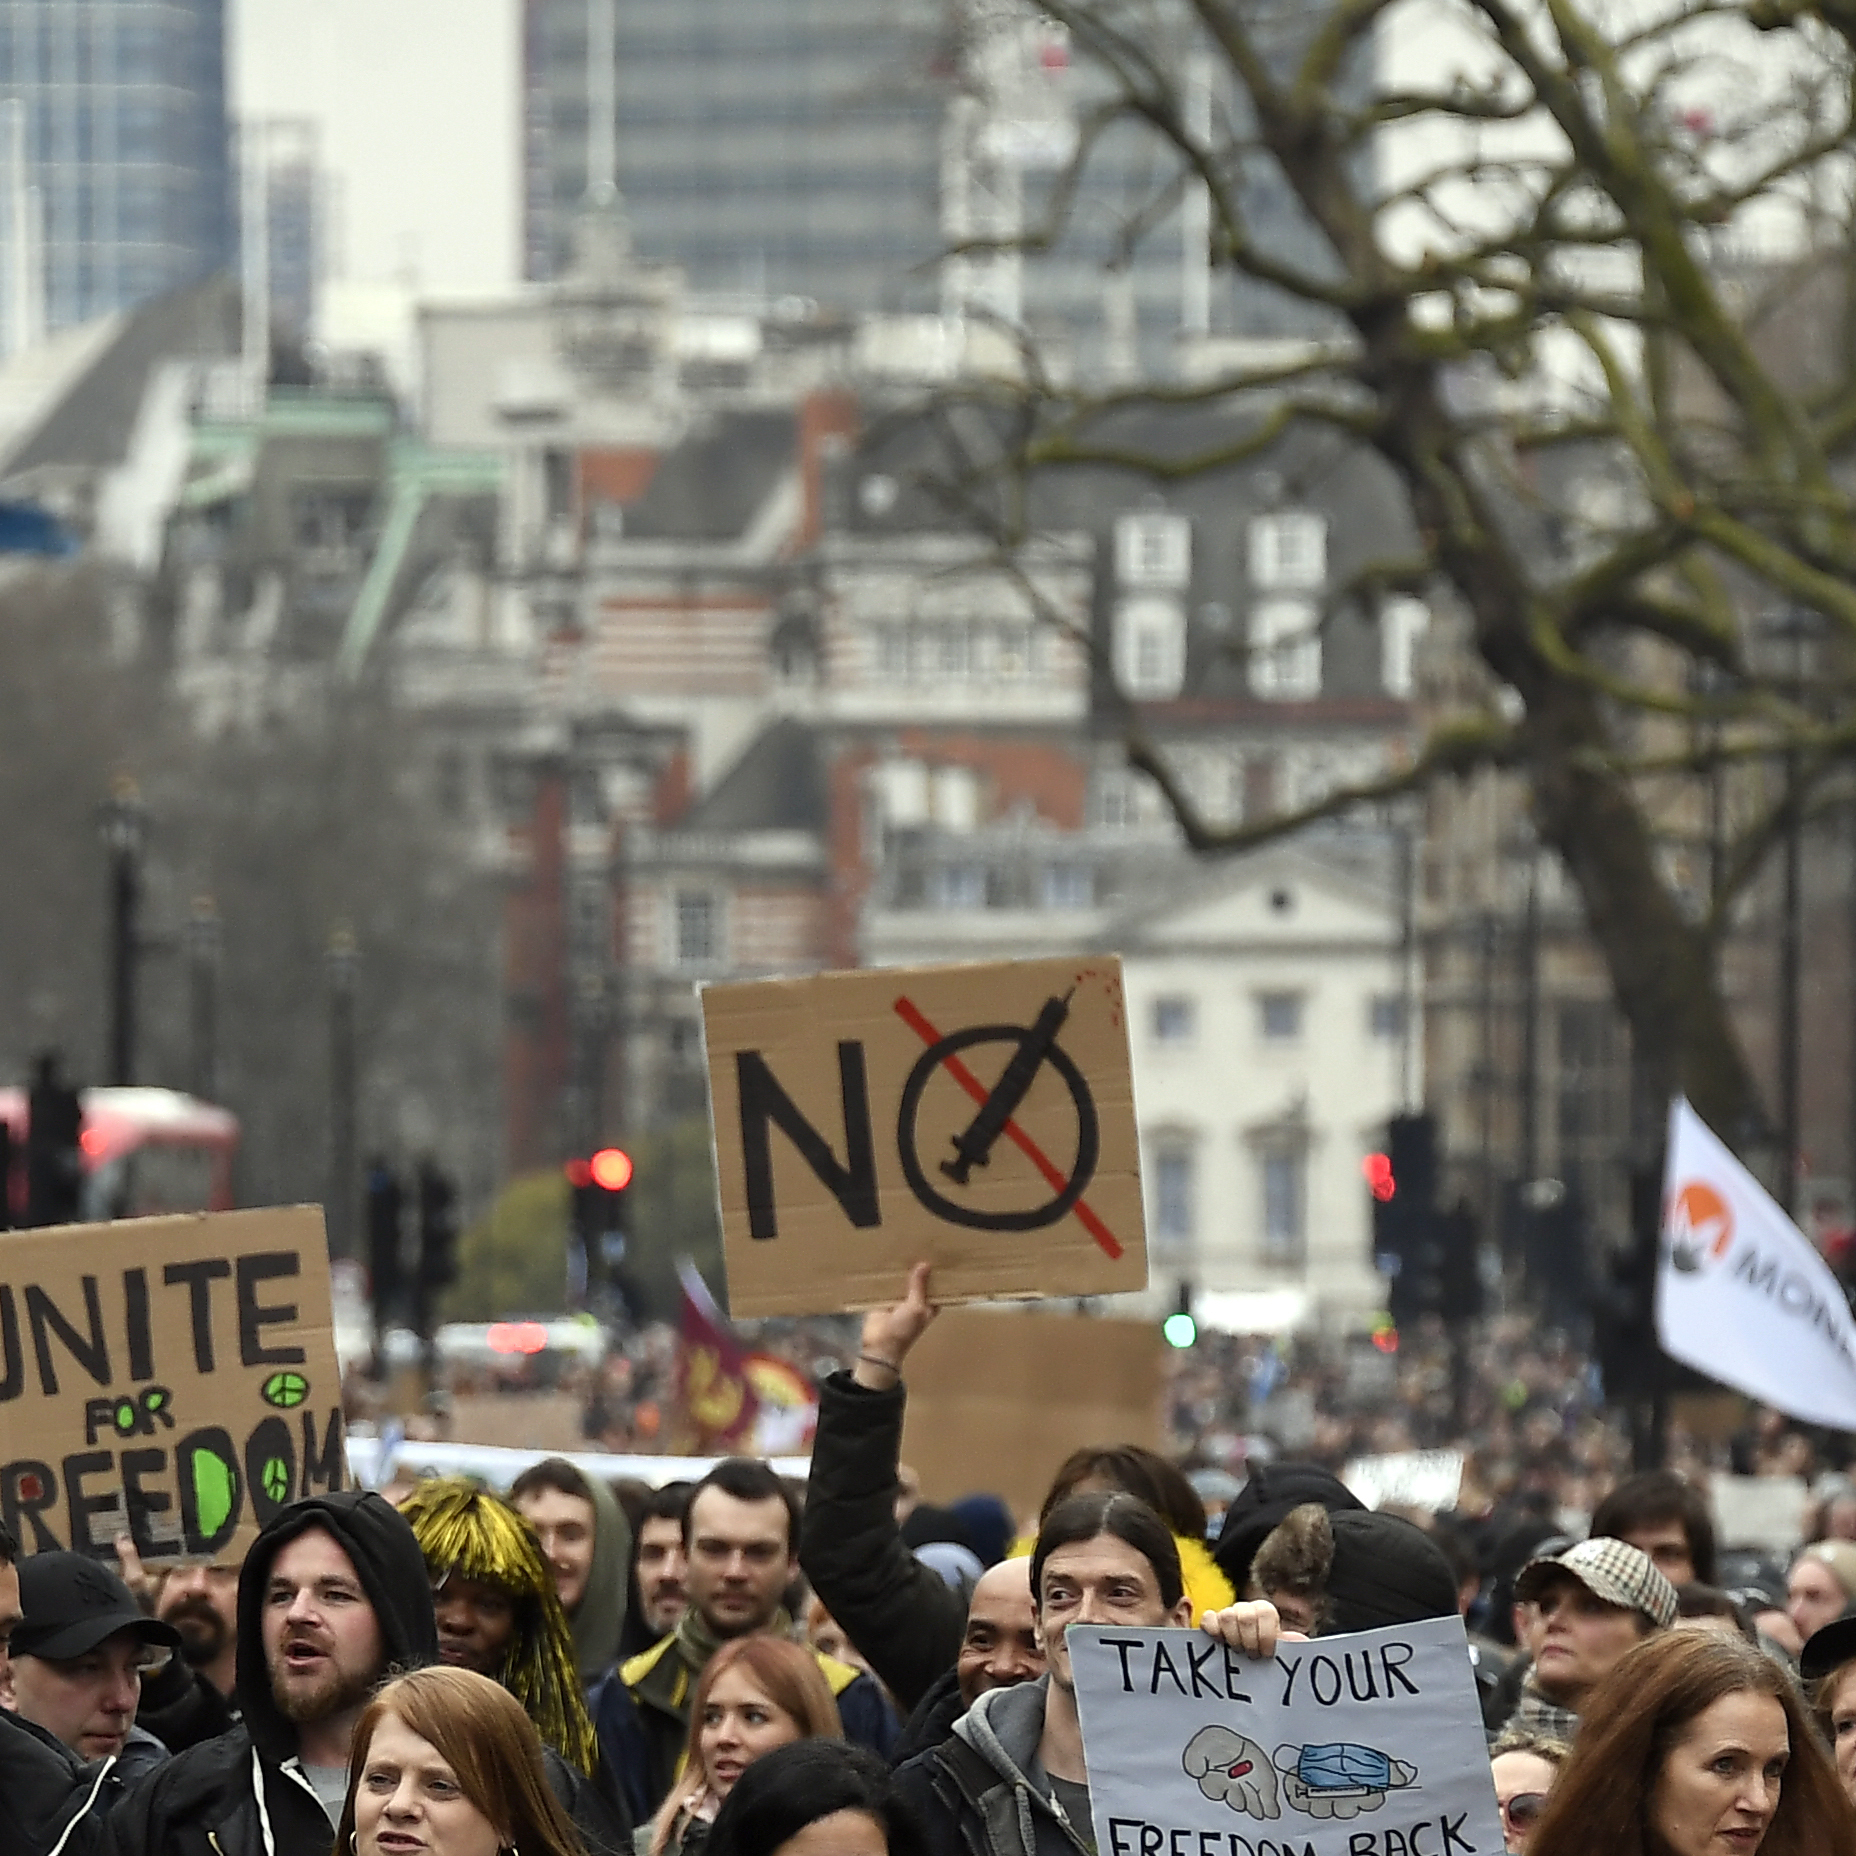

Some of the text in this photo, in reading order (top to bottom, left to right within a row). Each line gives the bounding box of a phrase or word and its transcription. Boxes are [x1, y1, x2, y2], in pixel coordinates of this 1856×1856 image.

[736, 1025, 1100, 1239] NO
[85, 1386, 175, 1445] FOR
[1099, 1637, 1421, 1707] TAKE YOUR
